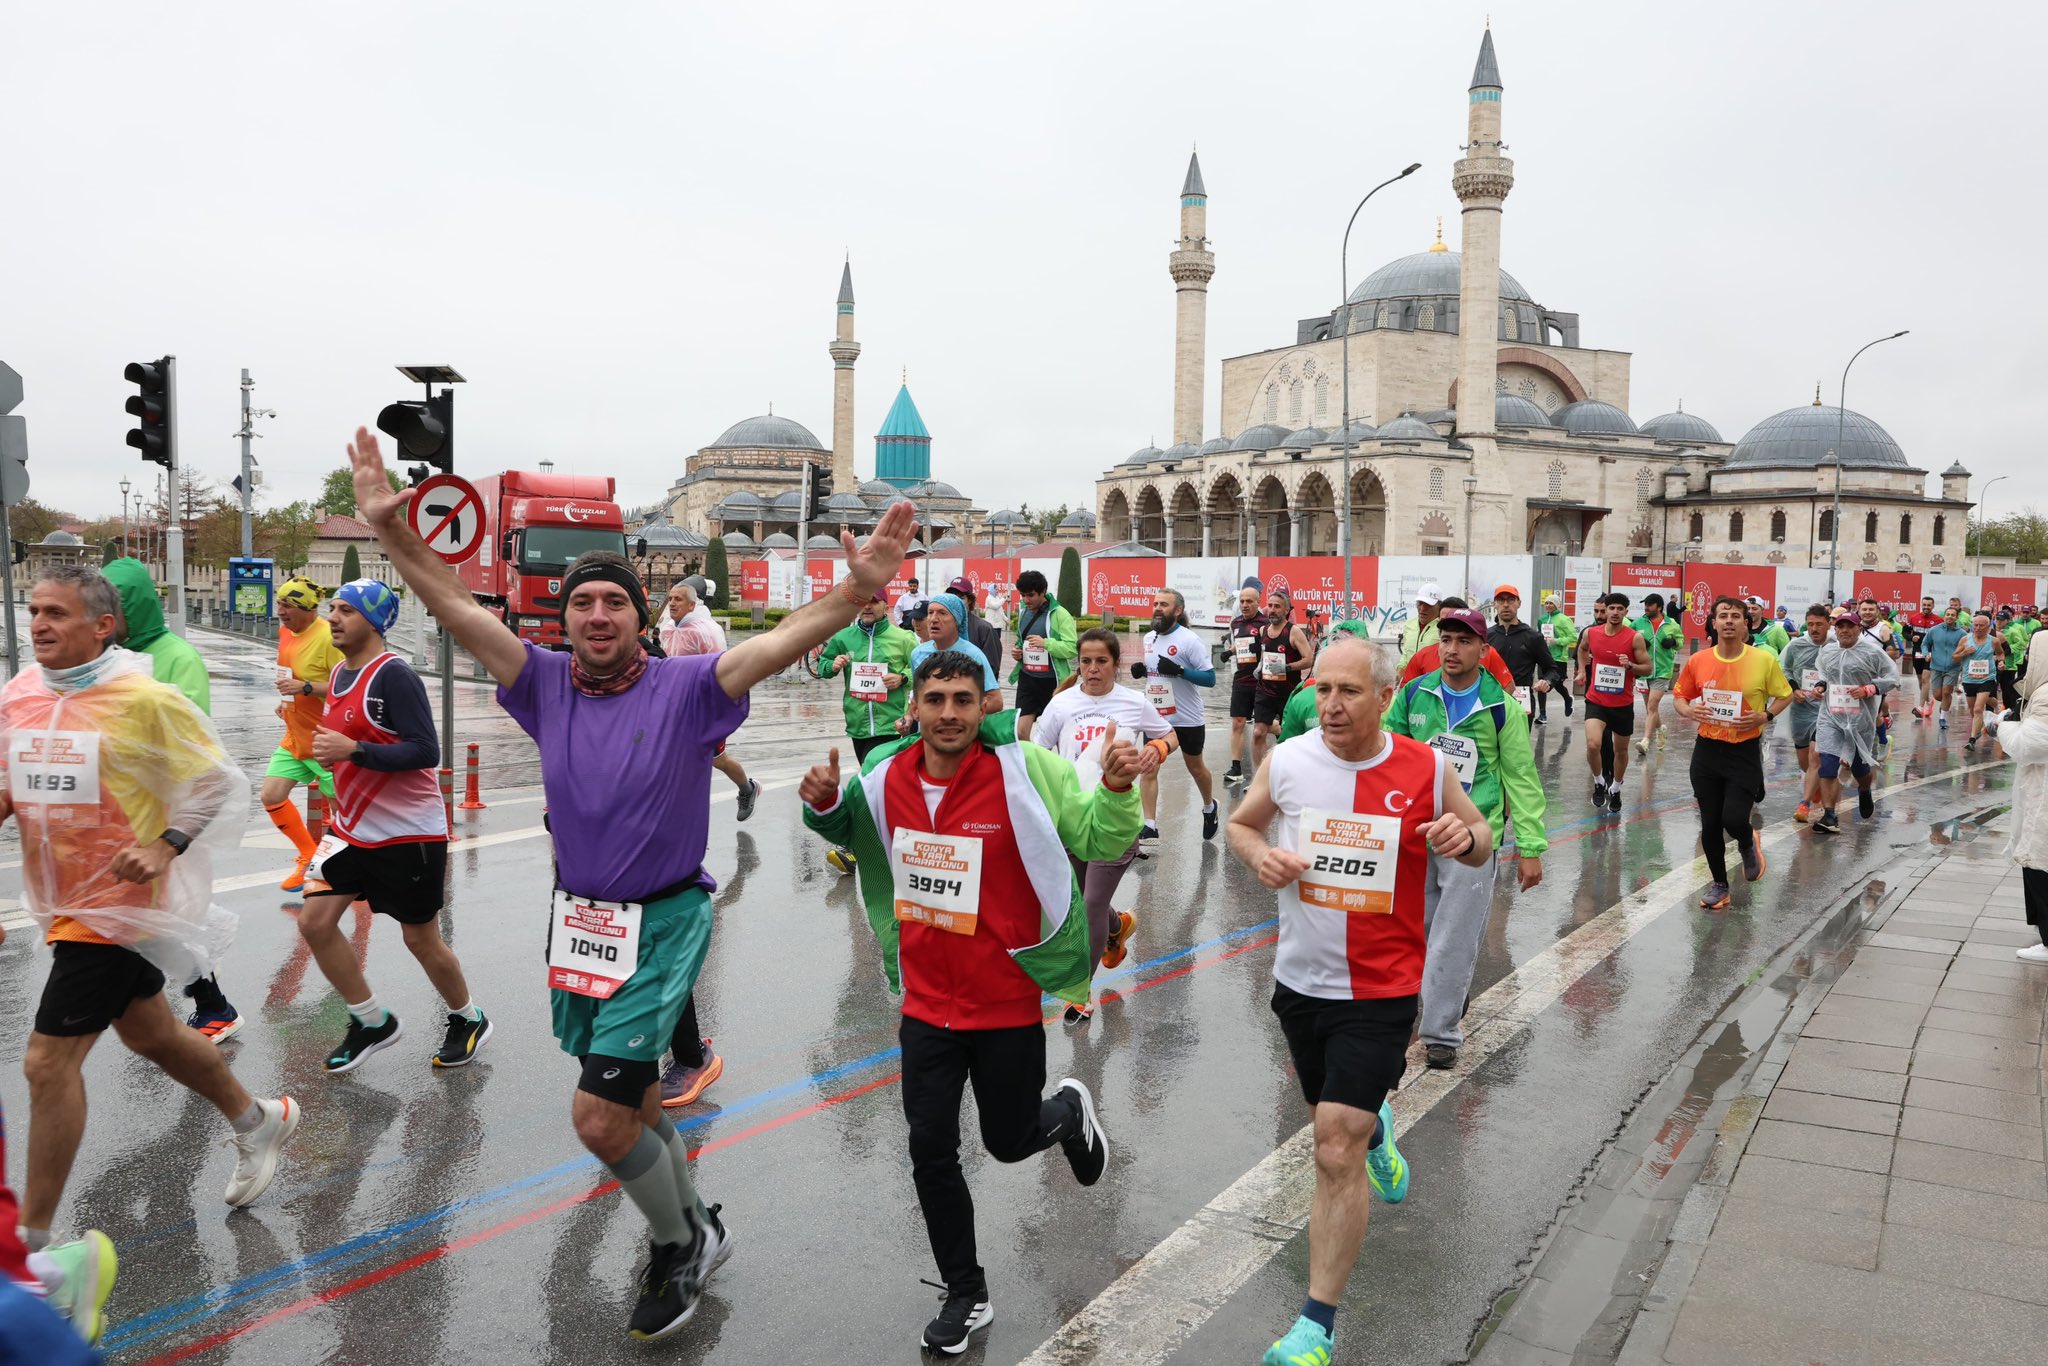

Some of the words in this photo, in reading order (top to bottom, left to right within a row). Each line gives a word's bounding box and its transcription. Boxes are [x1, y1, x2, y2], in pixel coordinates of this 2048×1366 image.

[545, 505, 564, 513] TÜRK
[570, 506, 607, 515] YILDIZLARI
[1321, 577, 1334, 587] T.C.
[1110, 583, 1131, 595] KÜLTÜR
[1131, 586, 1139, 595] VE
[1293, 588, 1321, 601] KÜLTÜR
[1322, 591, 1332, 601] VE
[1738, 585, 1749, 596] T.C.
[1120, 595, 1150, 607] BAKANLIĞI
[860, 680, 876, 688] 104
[1440, 737, 1463, 748] KONYA
[971, 821, 1001, 830] TÜMOSAN
[1329, 821, 1369, 832] KONYA
[1334, 828, 1361, 839] YARI
[1314, 834, 1381, 849] MARATONU
[916, 842, 952, 854] KONYA
[921, 851, 946, 861] YARI
[905, 855, 965, 870] MARATONU
[1314, 855, 1378, 877] 2205
[909, 873, 962, 896] 3994
[577, 906, 613, 919] KONYA
[581, 914, 604, 926] YARI
[567, 917, 624, 936] MARATONU
[570, 937, 618, 962] 1040
